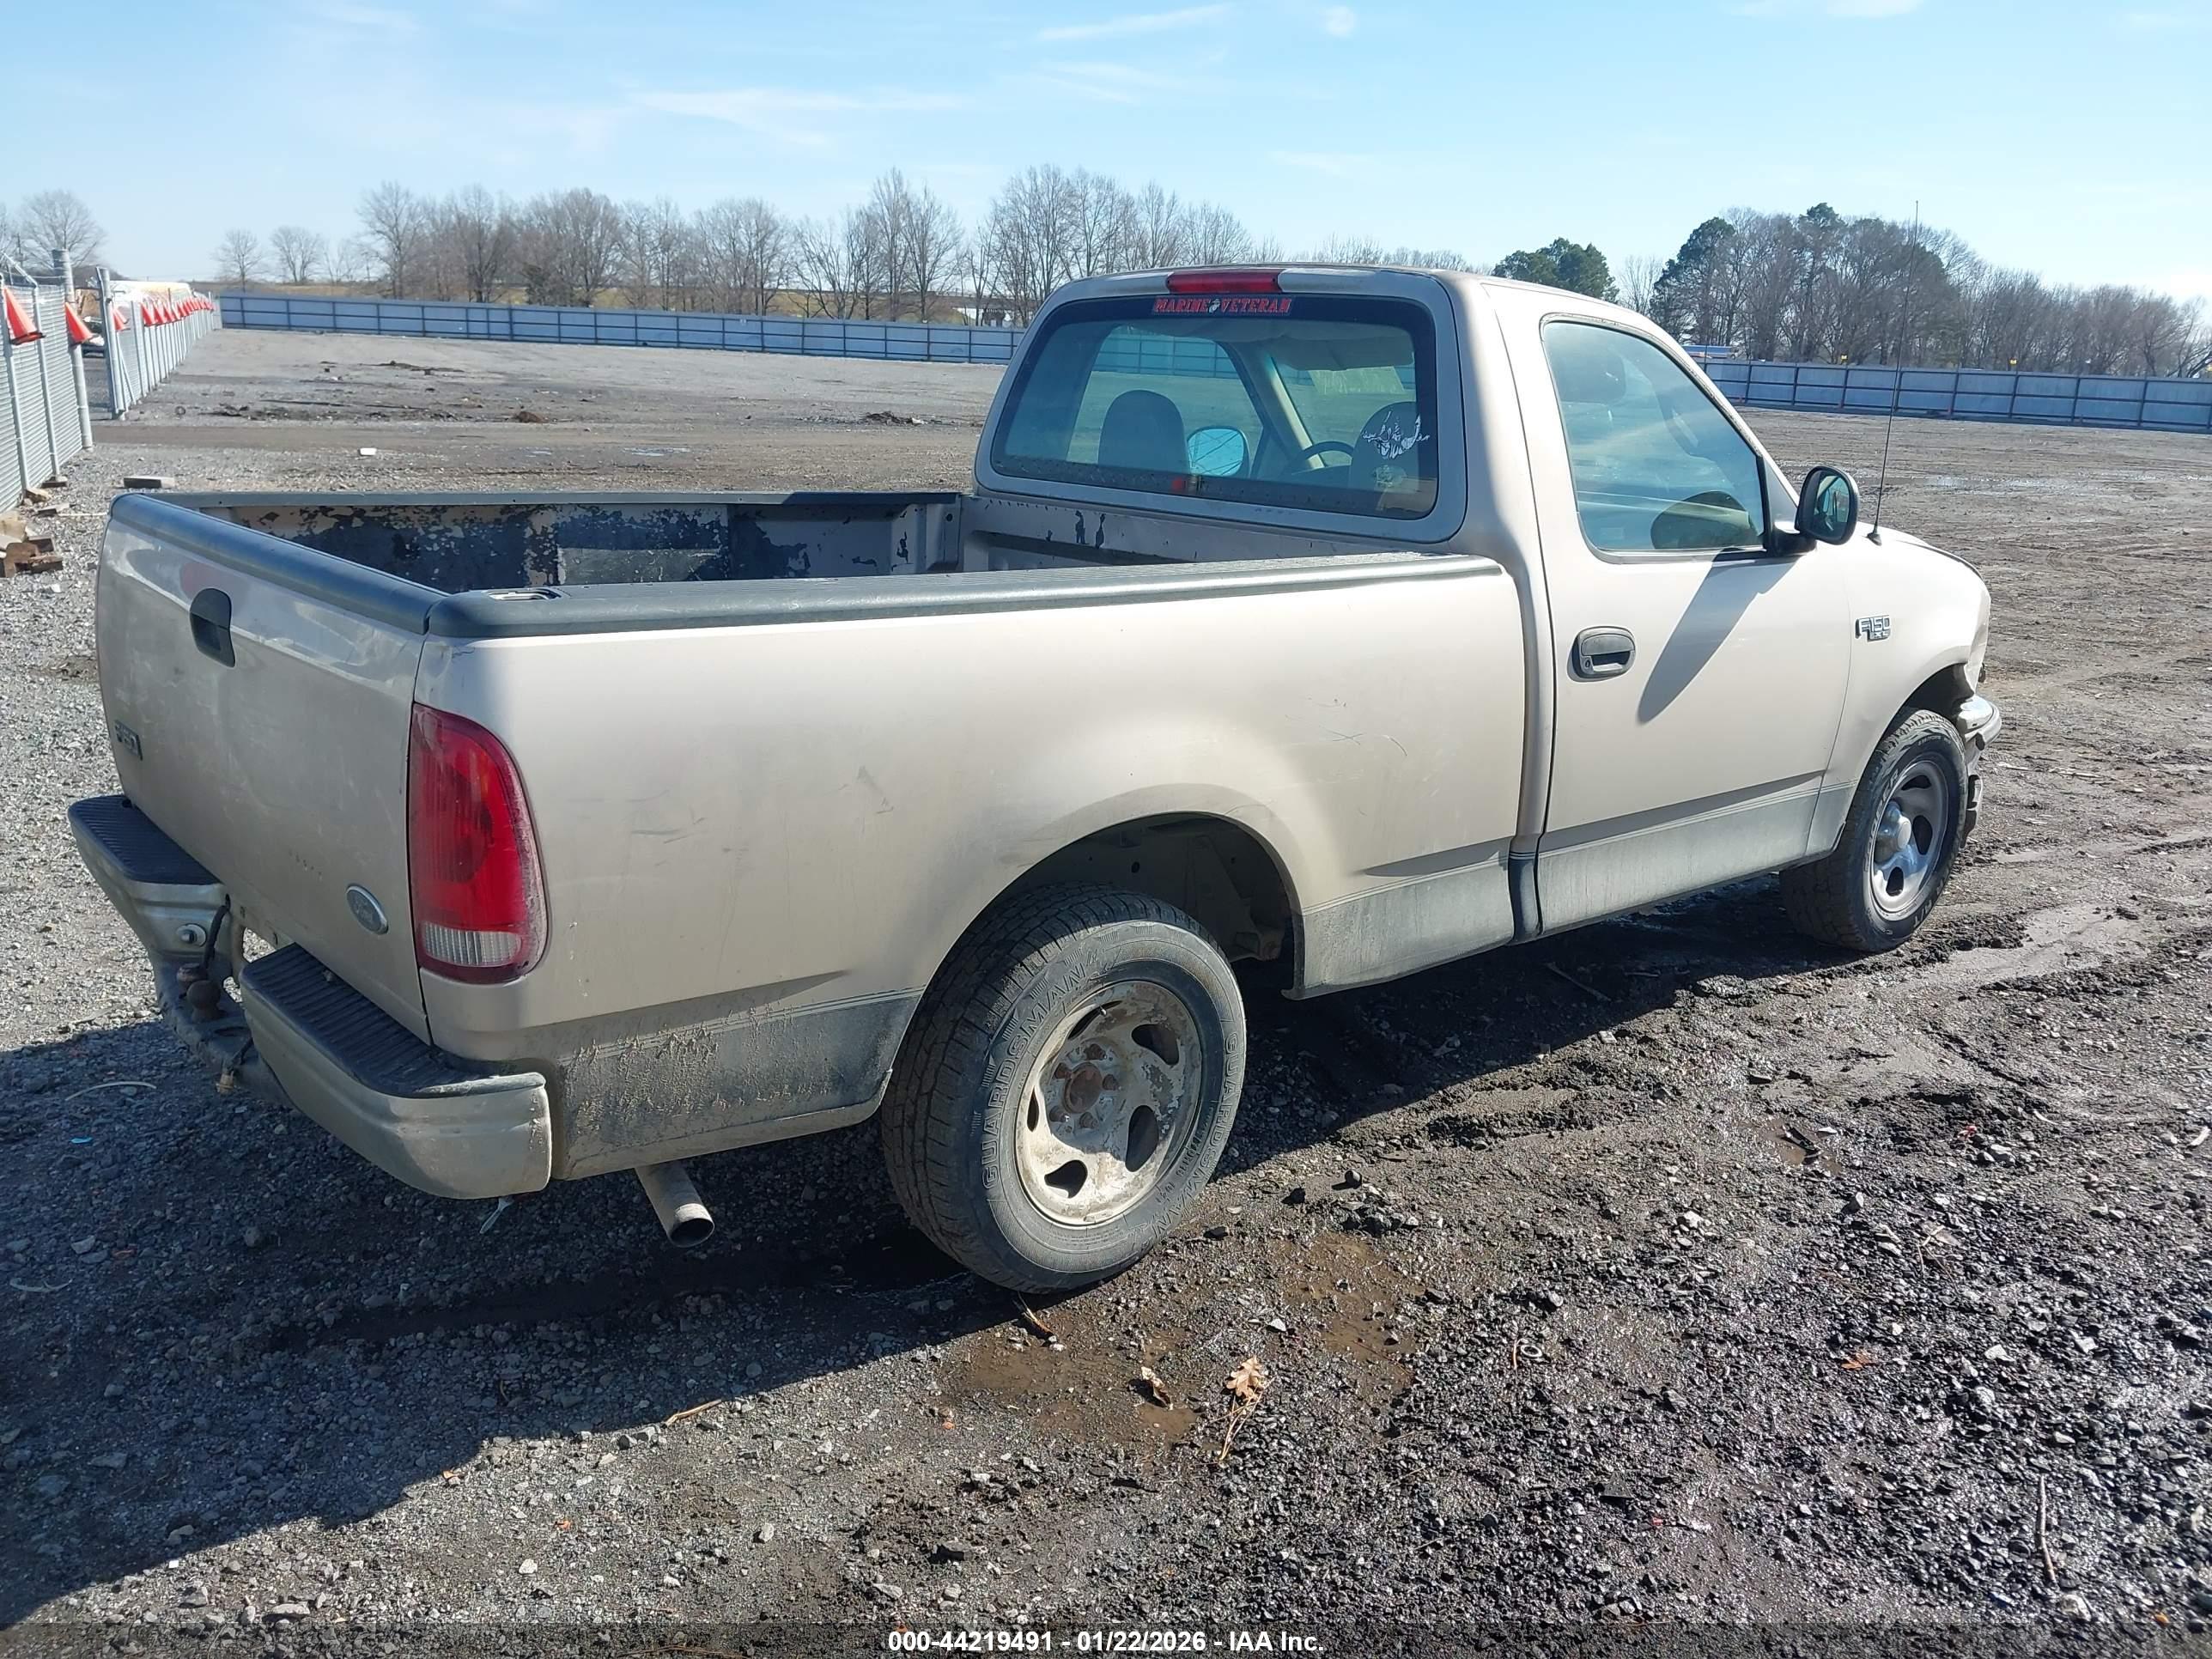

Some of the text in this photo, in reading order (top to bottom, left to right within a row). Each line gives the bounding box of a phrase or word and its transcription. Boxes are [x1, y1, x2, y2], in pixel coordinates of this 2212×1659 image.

[1154, 298, 1291, 313] MARINE VETERAN
[981, 961, 1087, 1190] GUARDSMAN
